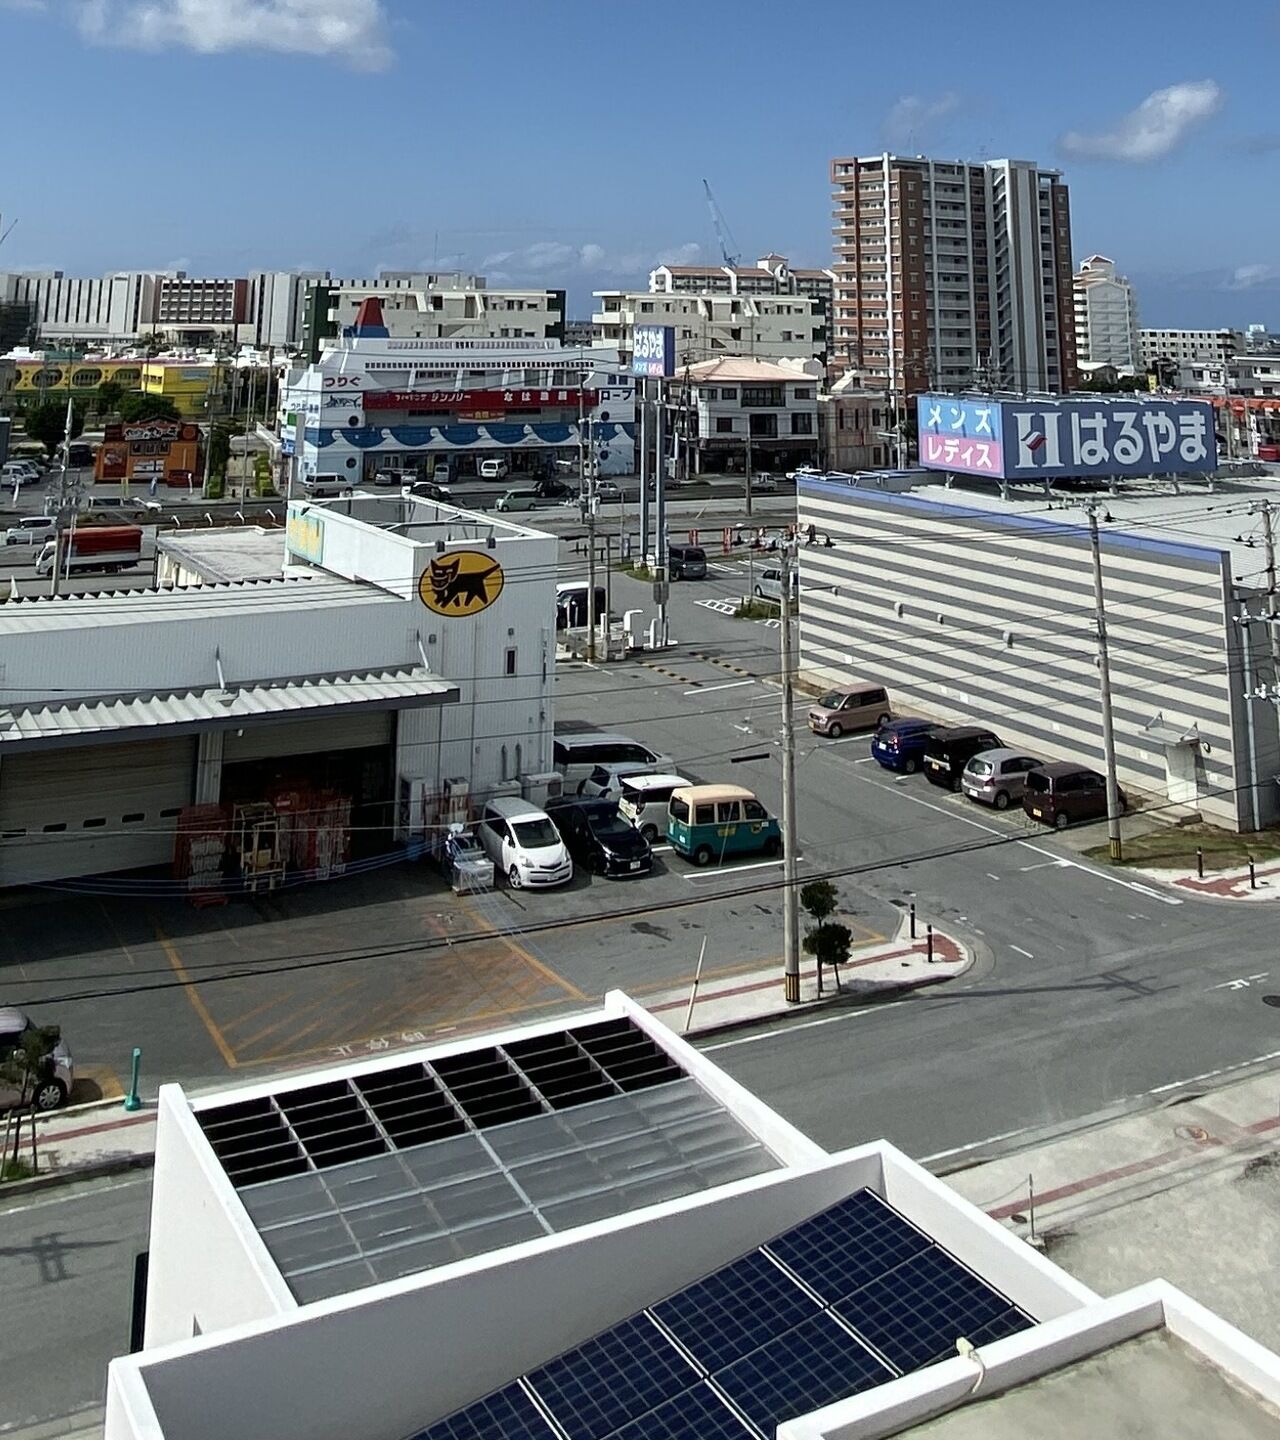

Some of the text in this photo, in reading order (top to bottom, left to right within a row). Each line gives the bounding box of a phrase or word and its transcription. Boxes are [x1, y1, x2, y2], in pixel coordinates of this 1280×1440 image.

[324, 375, 361, 388] つりぐ
[927, 404, 992, 434] メンズ
[927, 436, 993, 469] レディス
[1071, 411, 1208, 466] はるやま
